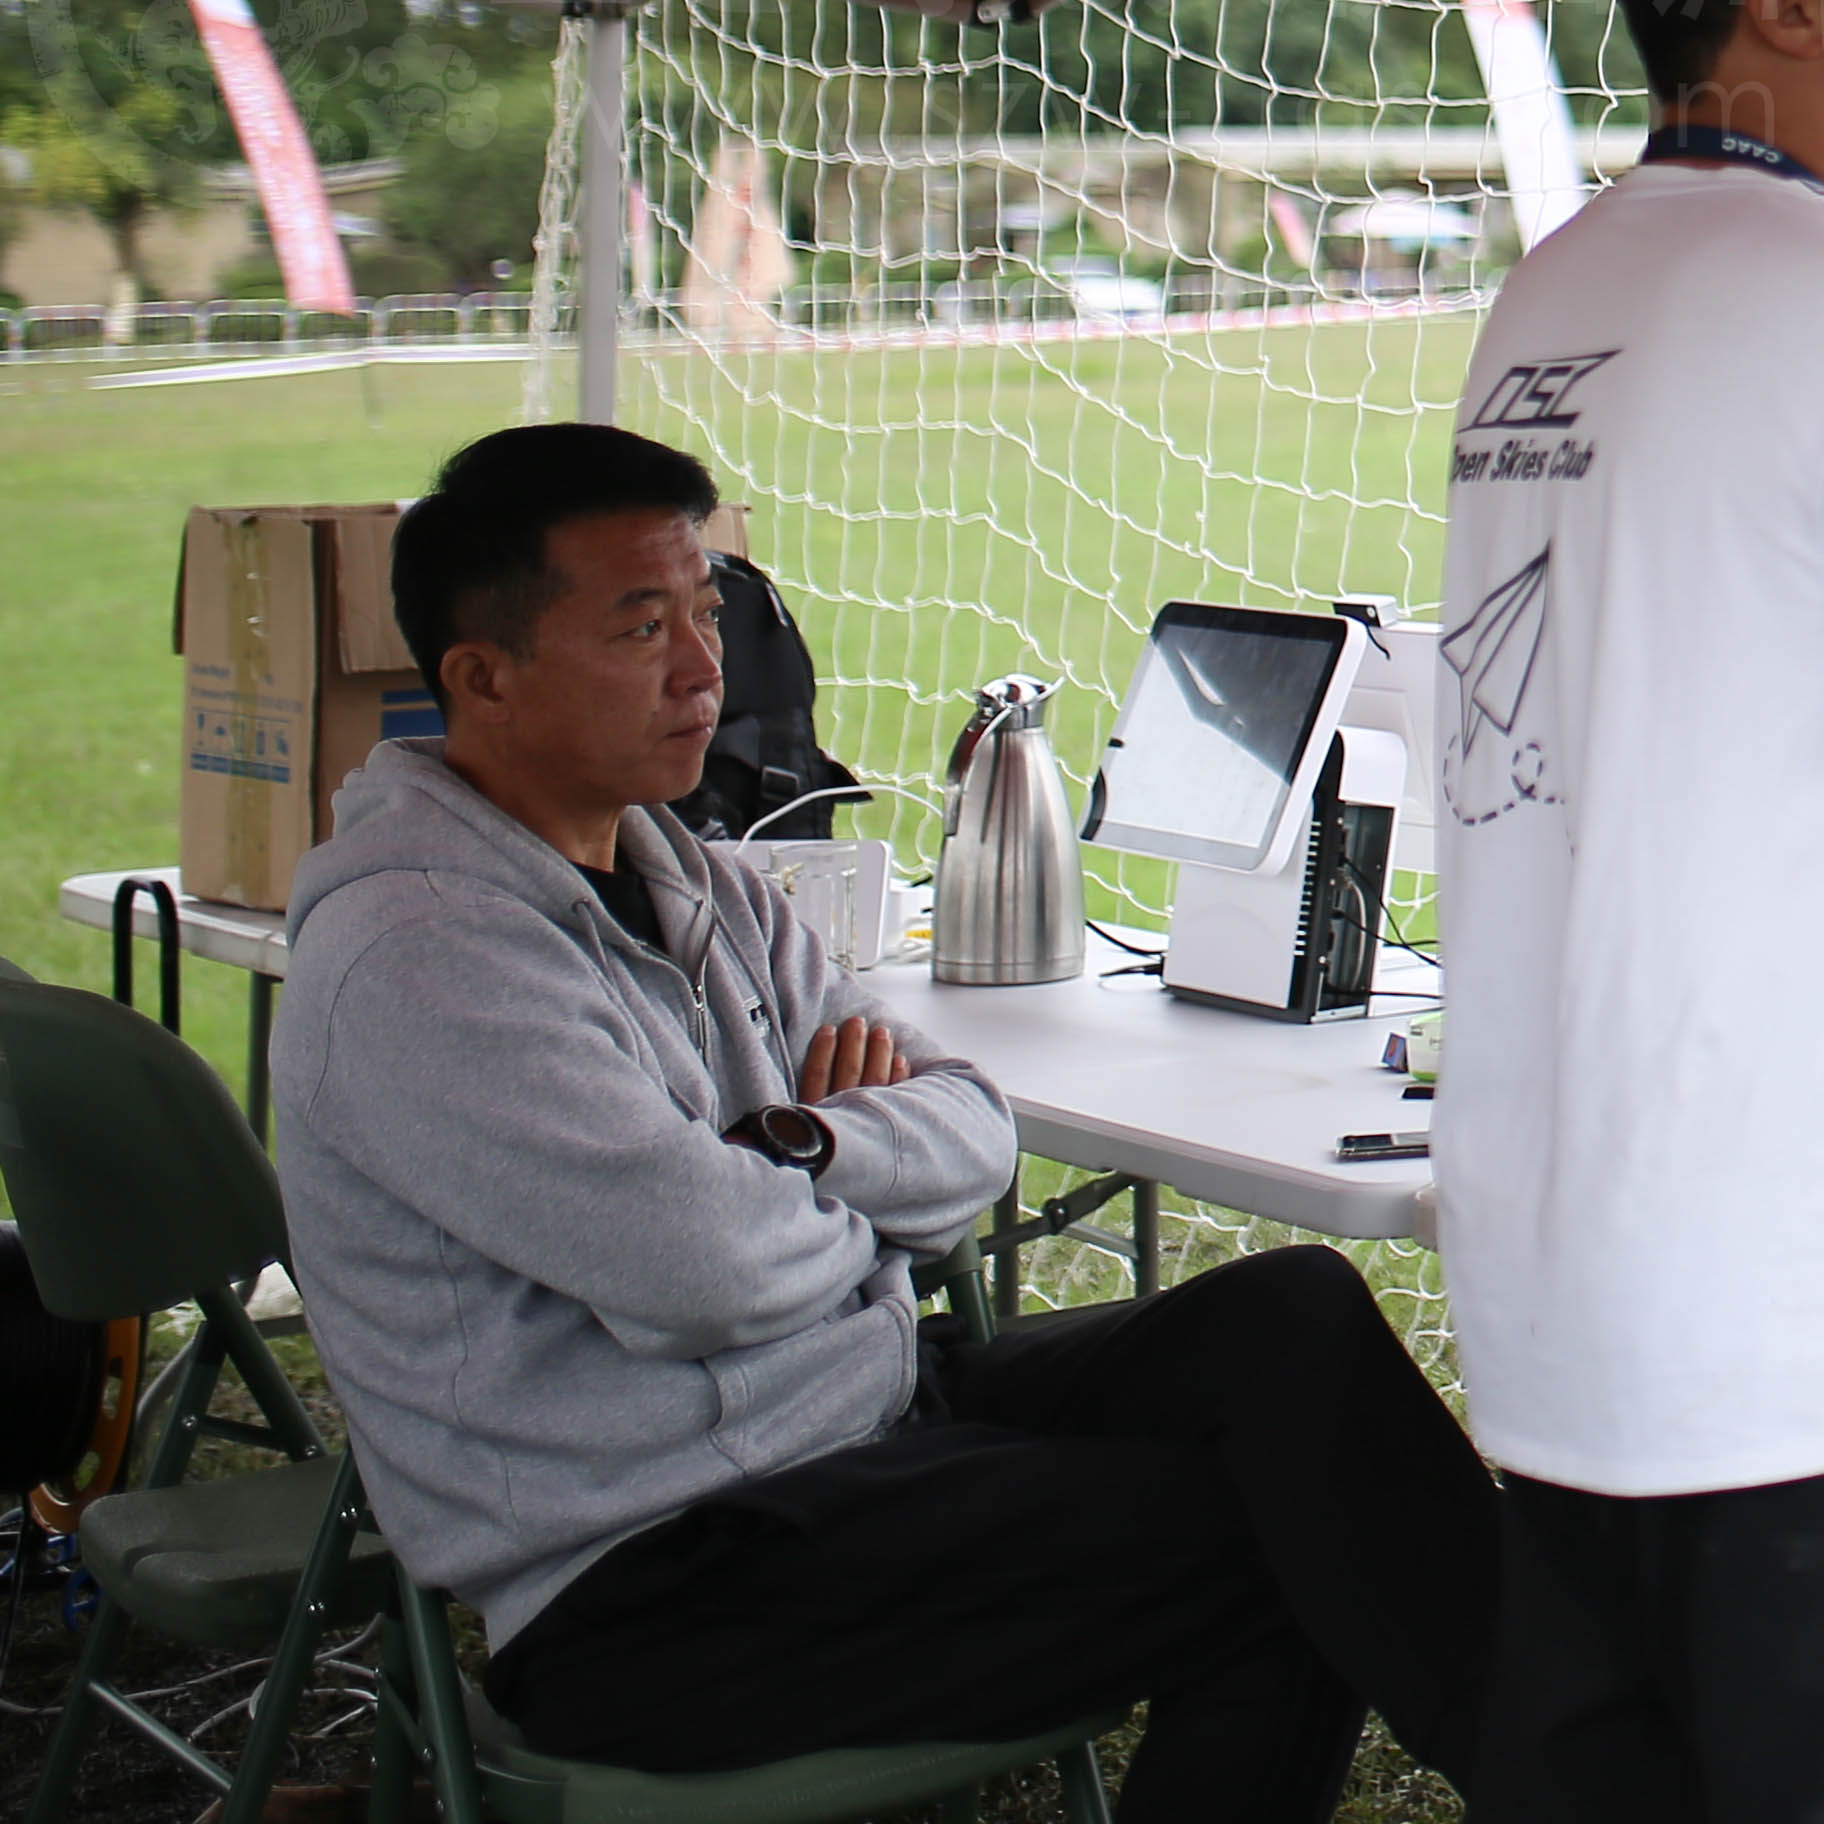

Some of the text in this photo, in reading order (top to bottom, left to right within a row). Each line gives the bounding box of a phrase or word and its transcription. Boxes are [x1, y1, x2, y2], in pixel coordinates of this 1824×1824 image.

[1721, 137, 1781, 163] CAAC
[1490, 440, 1549, 483] Skies
[1548, 440, 1596, 481] Club
